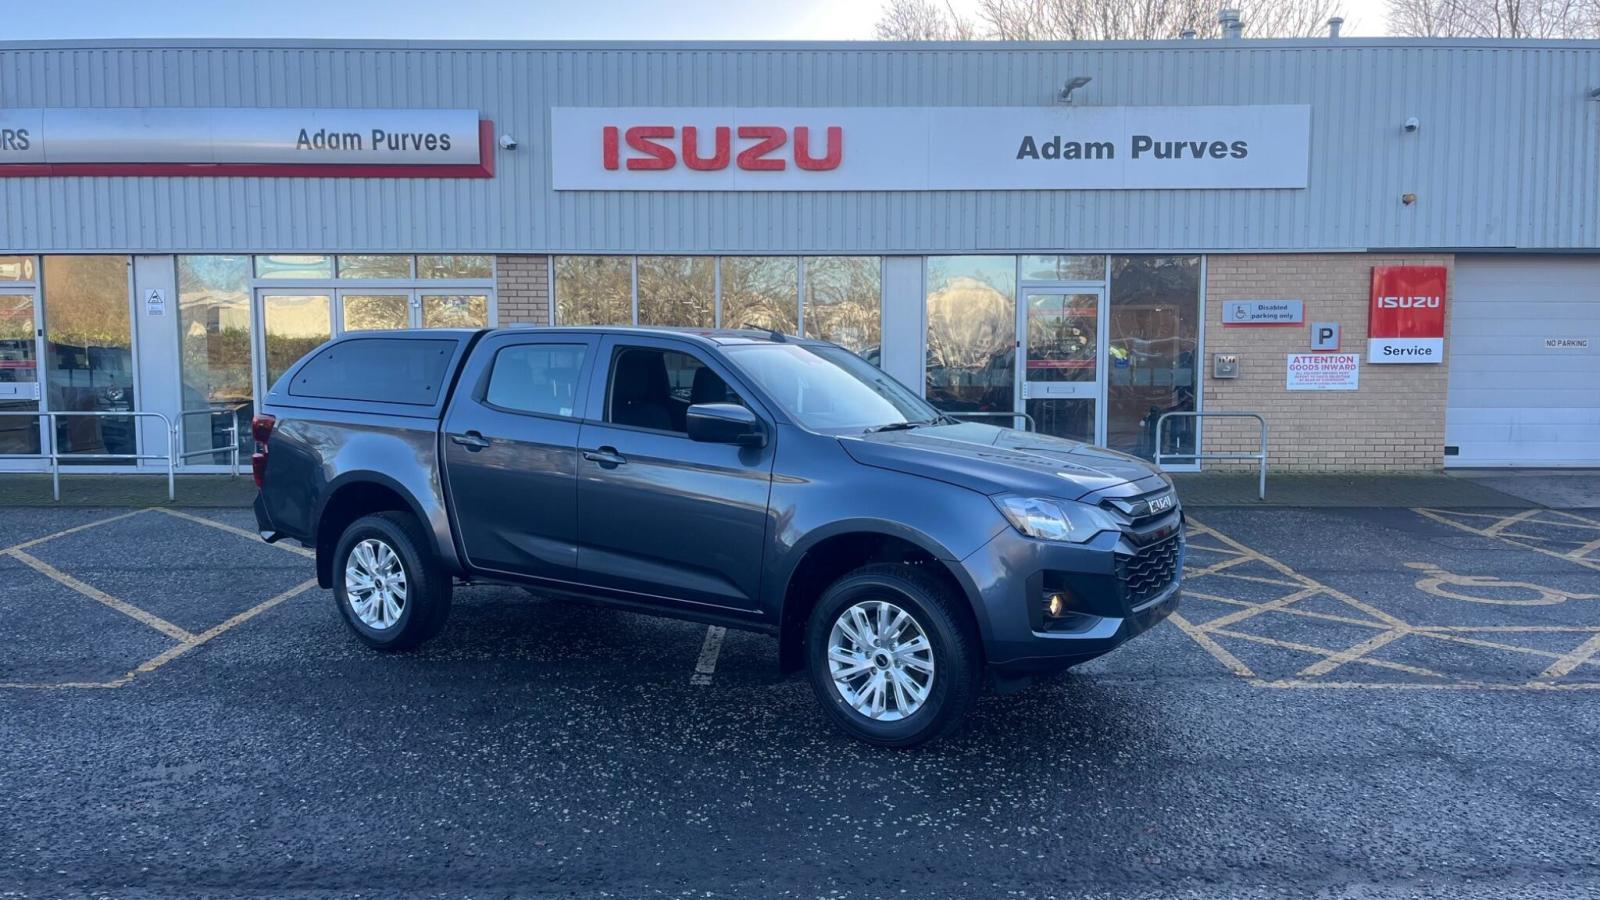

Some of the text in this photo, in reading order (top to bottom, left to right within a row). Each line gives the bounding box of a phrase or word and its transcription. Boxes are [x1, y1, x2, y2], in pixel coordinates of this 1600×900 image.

[0, 128, 30, 151] RS
[296, 128, 451, 151] Adam Purves
[602, 126, 842, 171] ISUZU
[1016, 135, 1248, 160] Adam Purves
[1377, 296, 1440, 308] ISUZU
[1319, 327, 1333, 345] P
[1293, 356, 1354, 364] ATTENTION
[1383, 345, 1432, 356] Service
